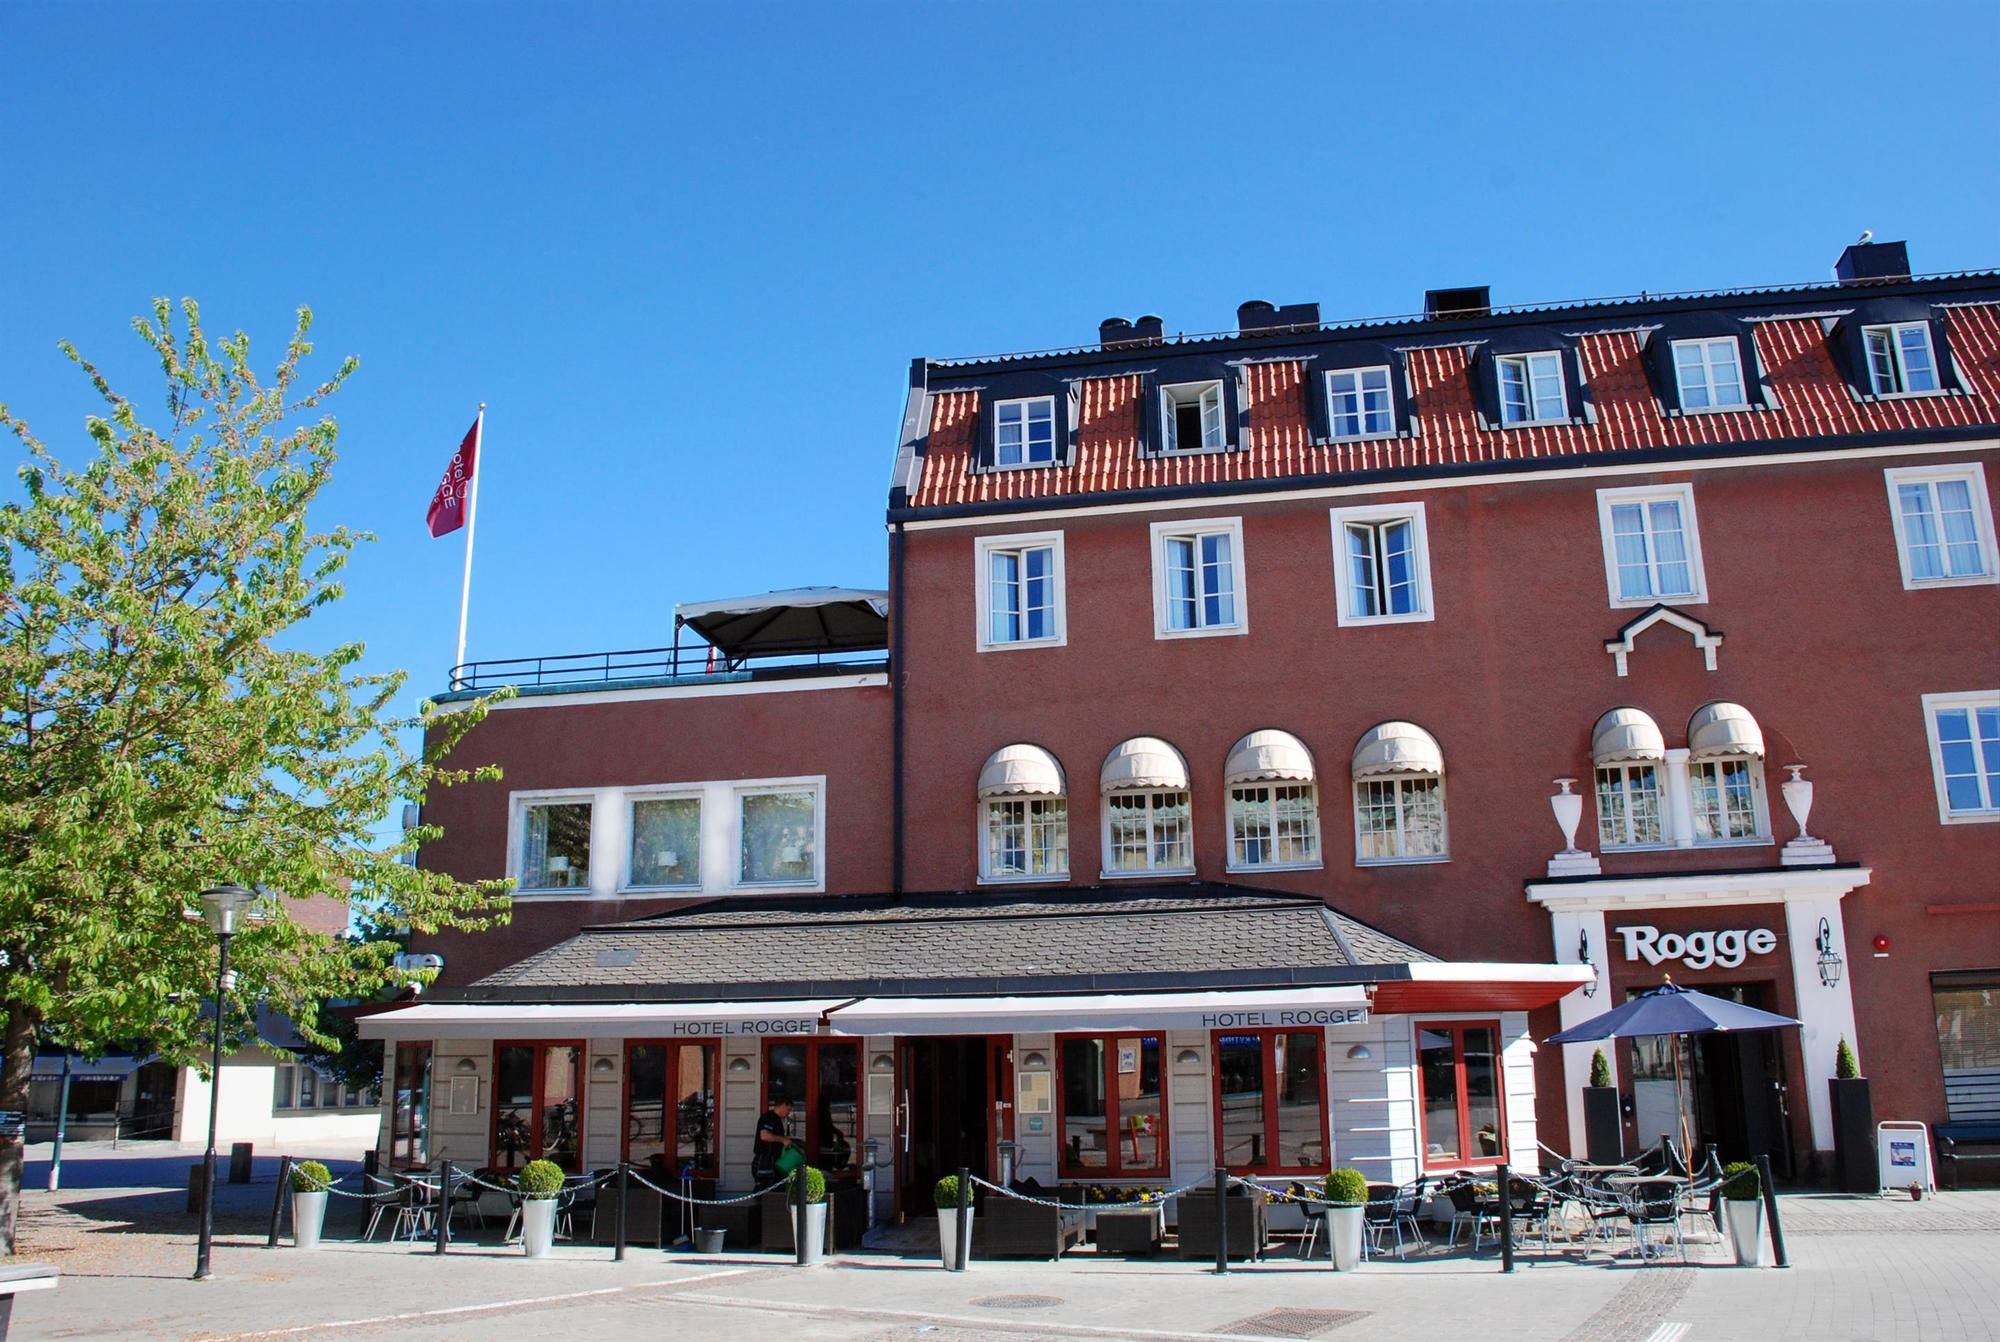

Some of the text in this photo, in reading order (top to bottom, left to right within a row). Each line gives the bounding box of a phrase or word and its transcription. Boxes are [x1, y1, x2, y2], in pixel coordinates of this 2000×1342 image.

[453, 444, 466, 482] otel
[441, 472, 456, 509] GGE
[1615, 925, 1777, 970] Rogge
[673, 1019, 811, 1035] HOTEL ROGGE
[1202, 1009, 1360, 1027] HOTEL ROGGE
